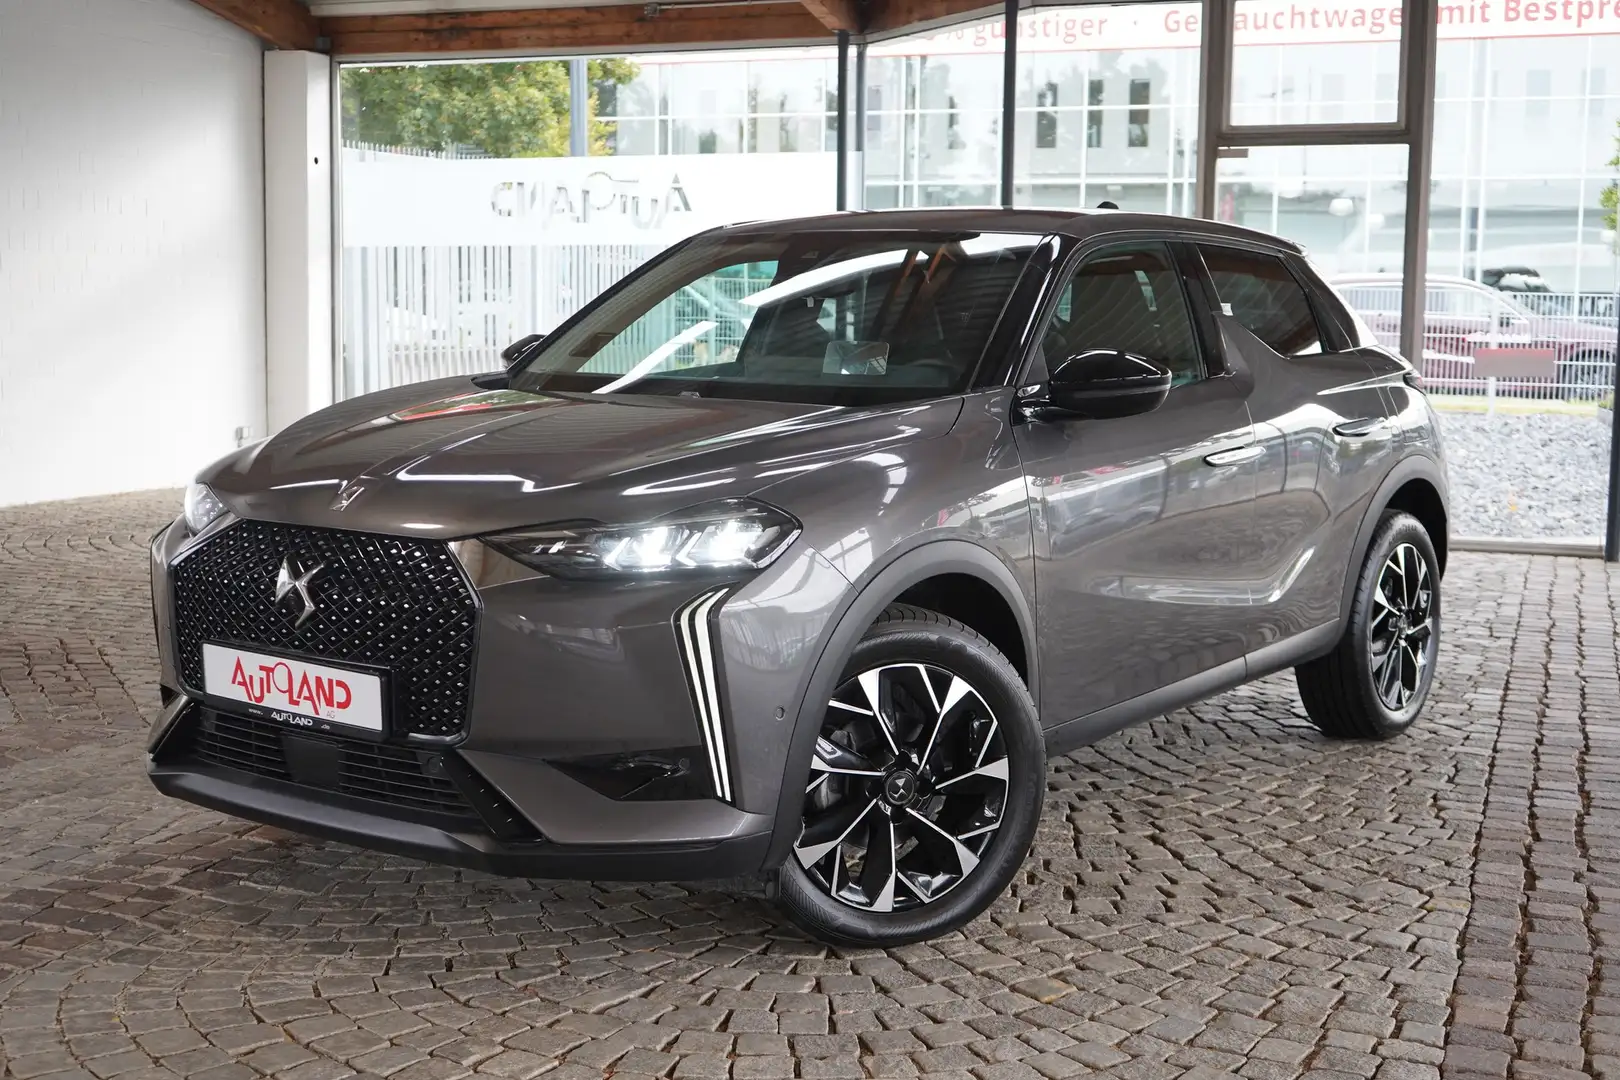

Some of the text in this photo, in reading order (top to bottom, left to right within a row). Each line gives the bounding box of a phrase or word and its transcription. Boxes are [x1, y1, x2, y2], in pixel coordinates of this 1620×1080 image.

[1164, 5, 1402, 34] Geauchtwage
[1437, 2, 1490, 24] mit
[232, 656, 352, 715] AUTOLAND
[271, 711, 313, 726] AUTOLAND
[326, 710, 336, 719] AG
